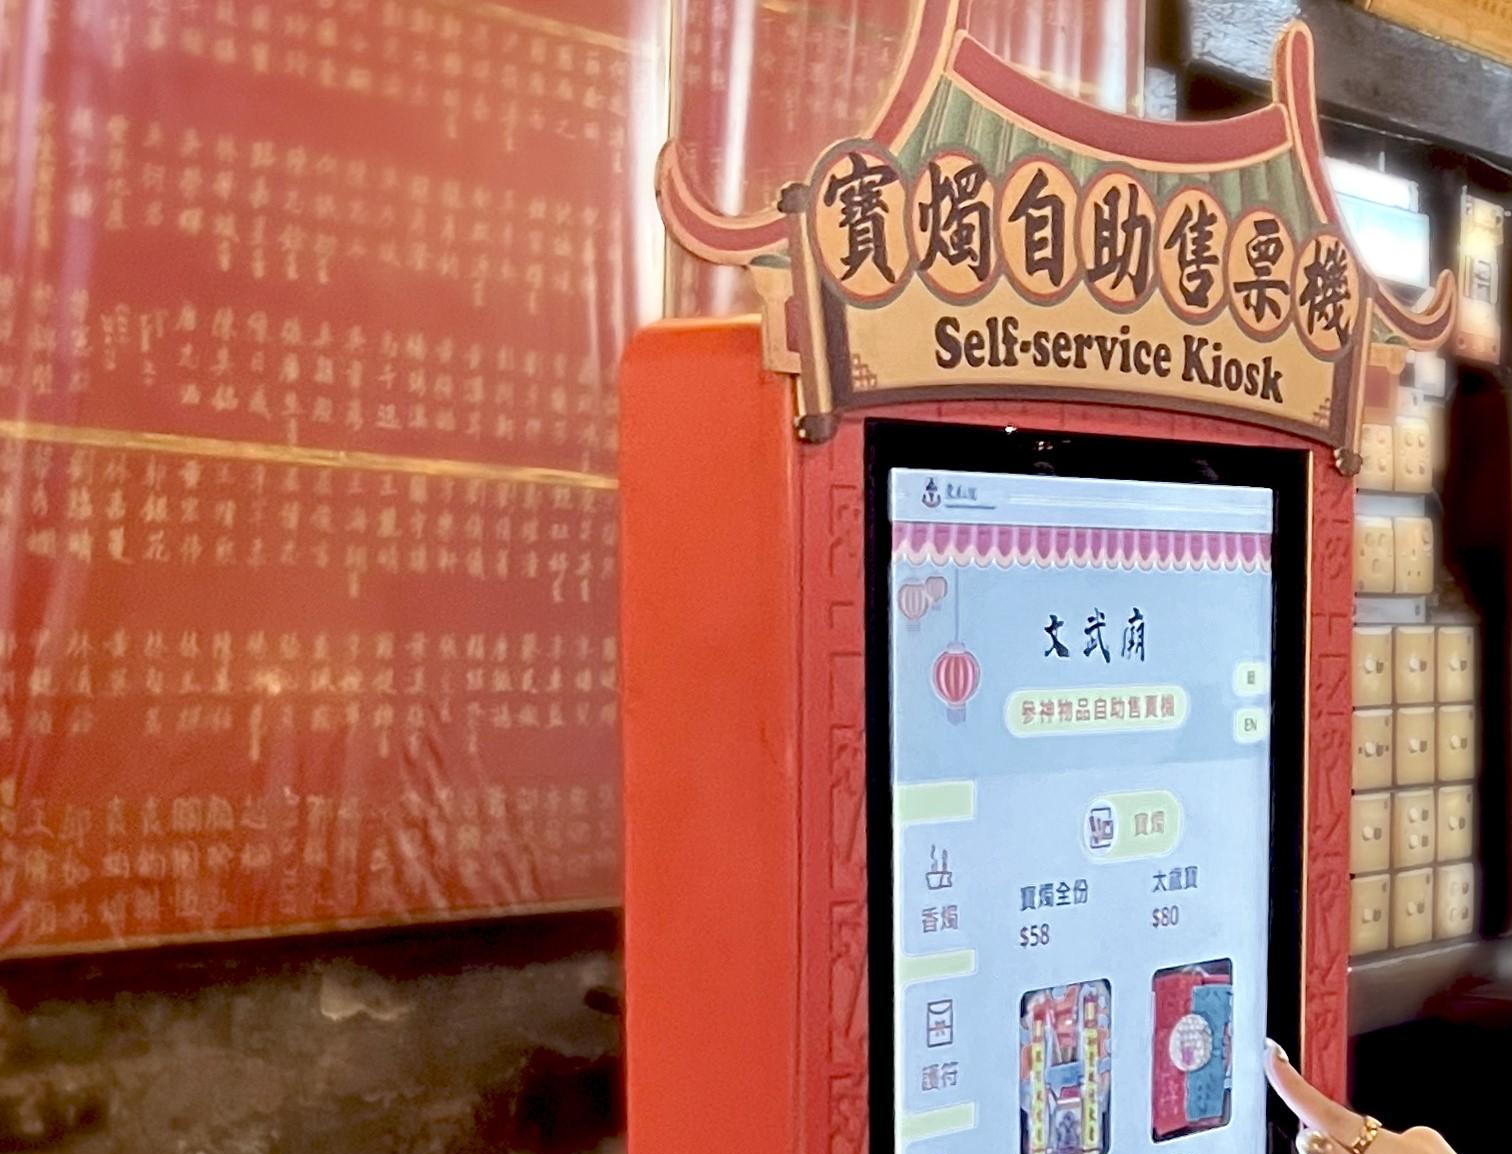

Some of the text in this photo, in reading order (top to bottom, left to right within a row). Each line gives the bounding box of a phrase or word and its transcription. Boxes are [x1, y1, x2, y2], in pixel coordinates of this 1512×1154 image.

[824, 152, 1353, 348] 寶燭自助售票機
[934, 316, 1284, 404] Self-service Kiosk
[1019, 923, 1050, 947] $58
[1152, 905, 1179, 928] $80
